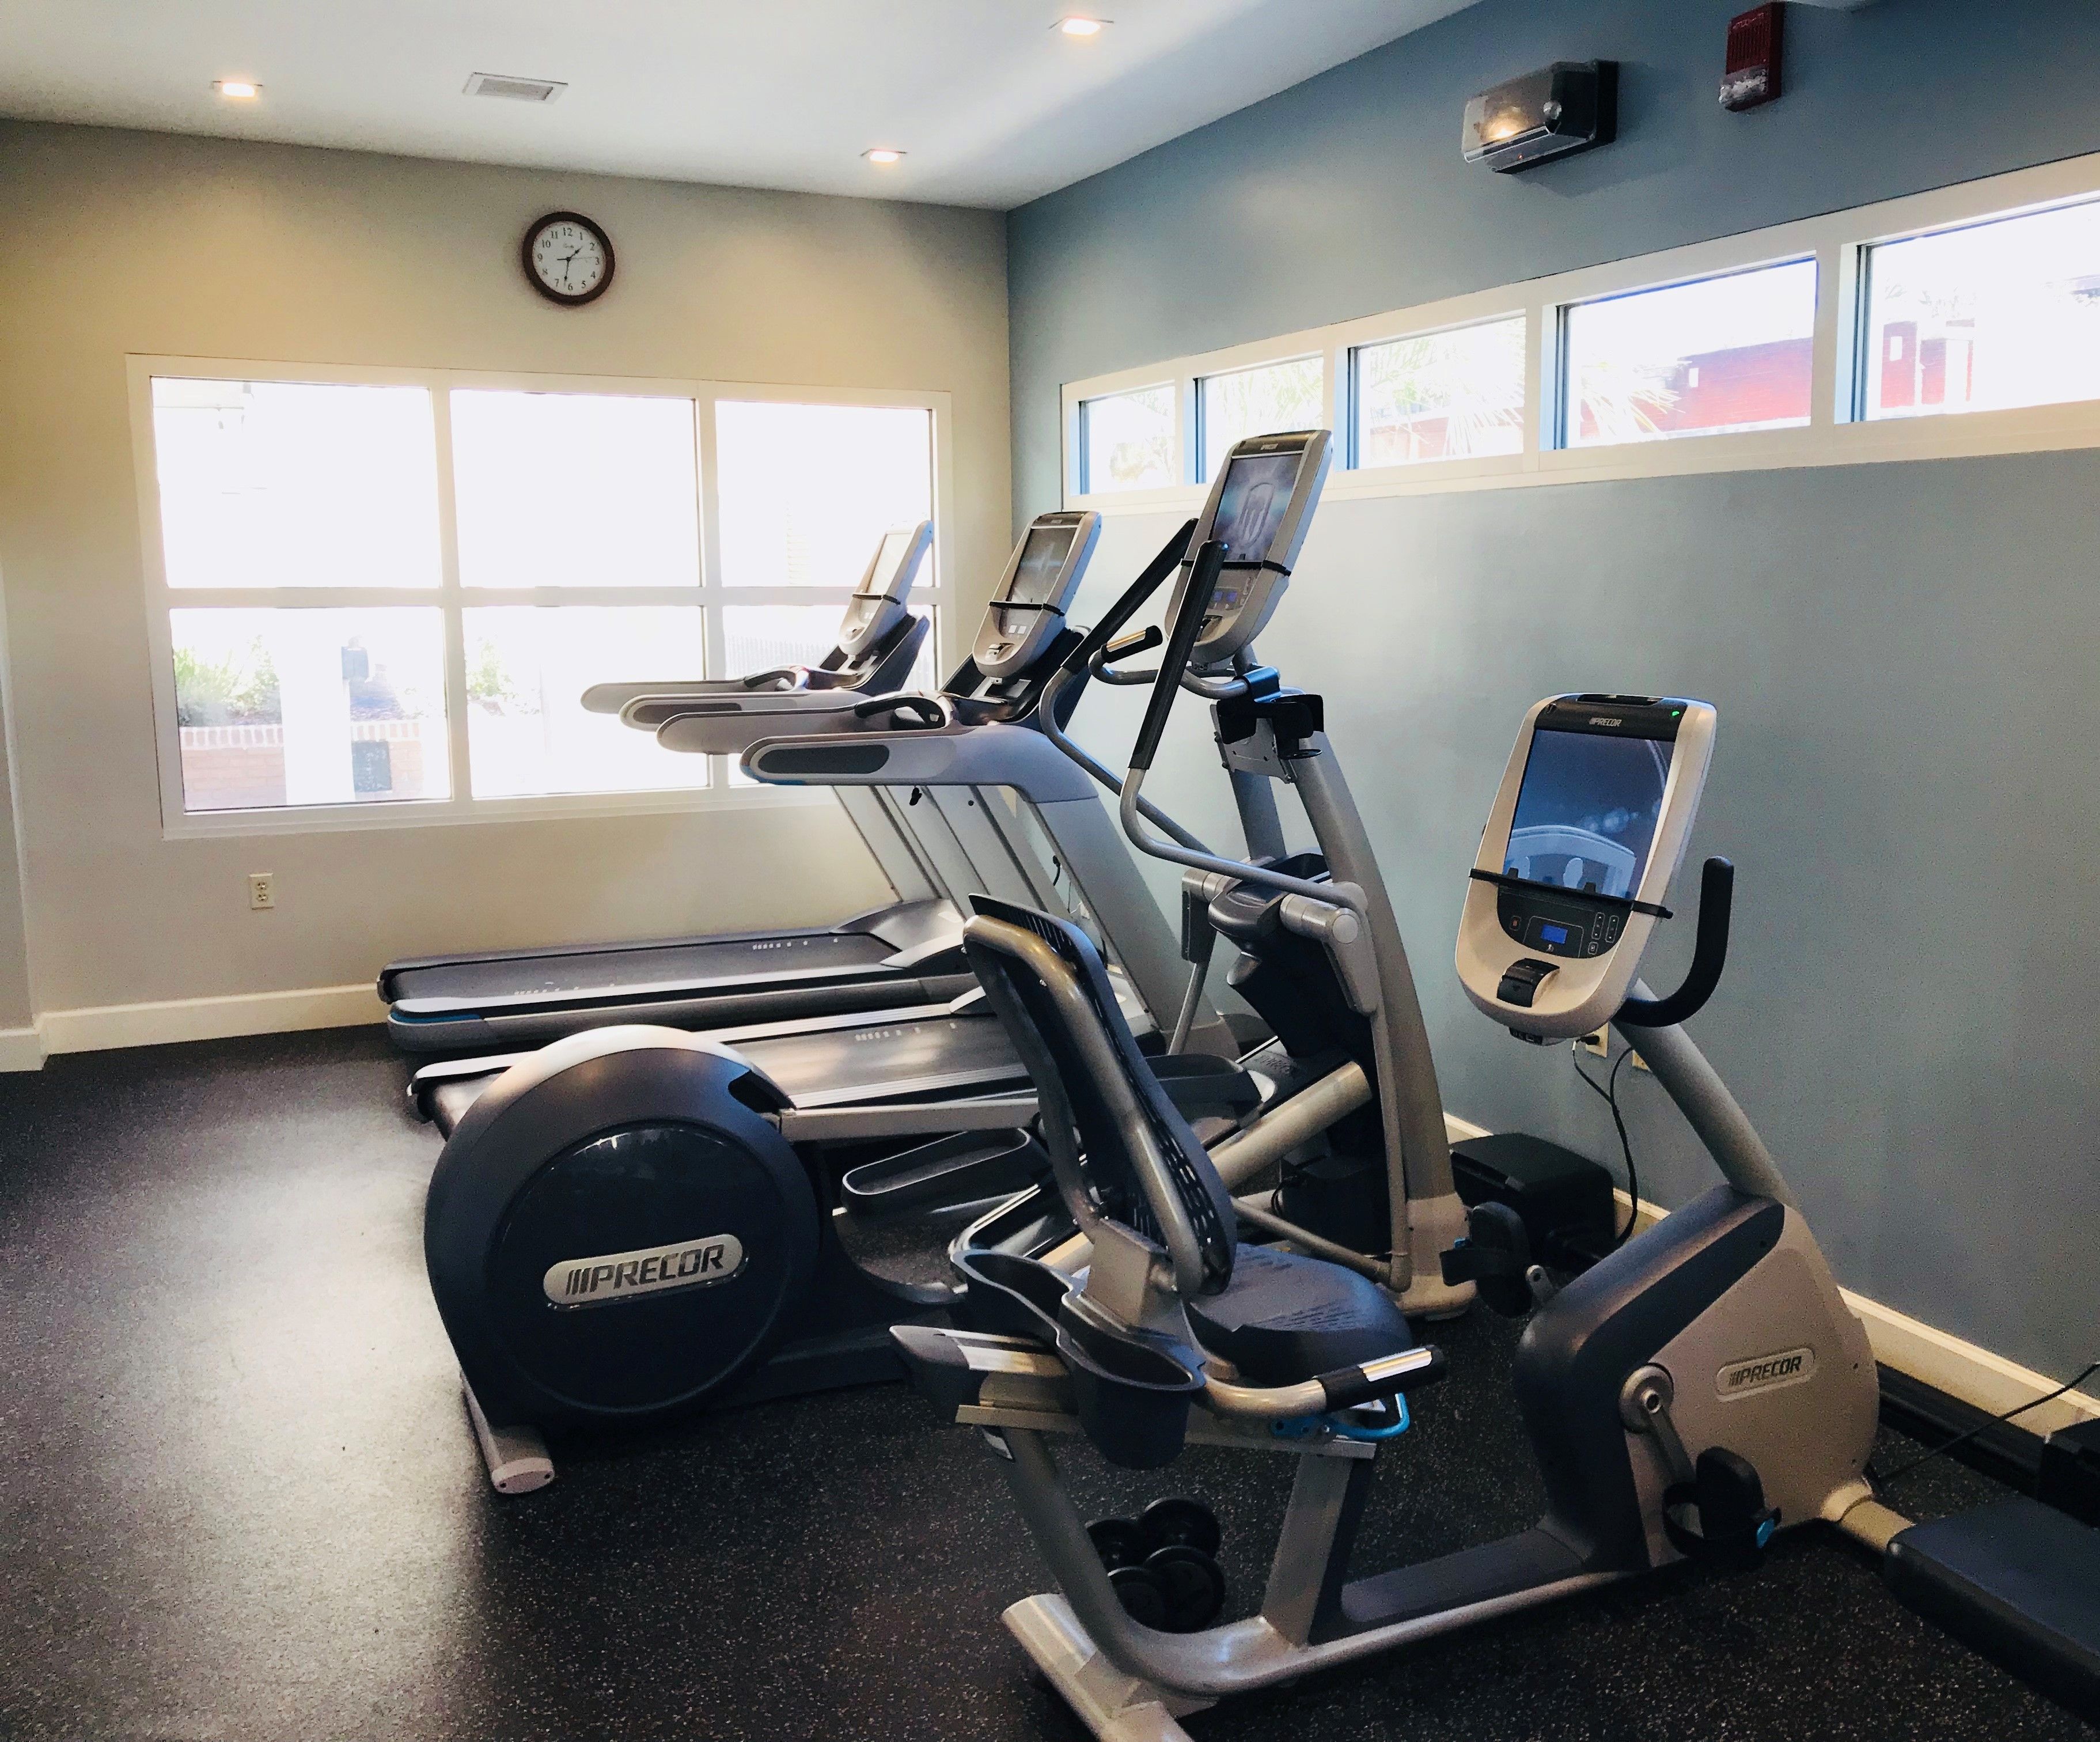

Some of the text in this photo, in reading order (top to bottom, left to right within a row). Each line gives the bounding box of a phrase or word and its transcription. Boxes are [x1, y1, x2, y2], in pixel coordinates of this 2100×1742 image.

[551, 231, 558, 239] 11
[563, 228, 573, 237] 12
[580, 232, 583, 240] 1
[542, 239, 551, 248] 10
[590, 243, 595, 251] 2
[537, 253, 543, 262] 9
[595, 257, 600, 265] 3
[590, 271, 596, 279] 4
[555, 278, 559, 287] 7
[589, 1244, 725, 1293] PRECOR
[1739, 1355, 1802, 1385] PRECOR
